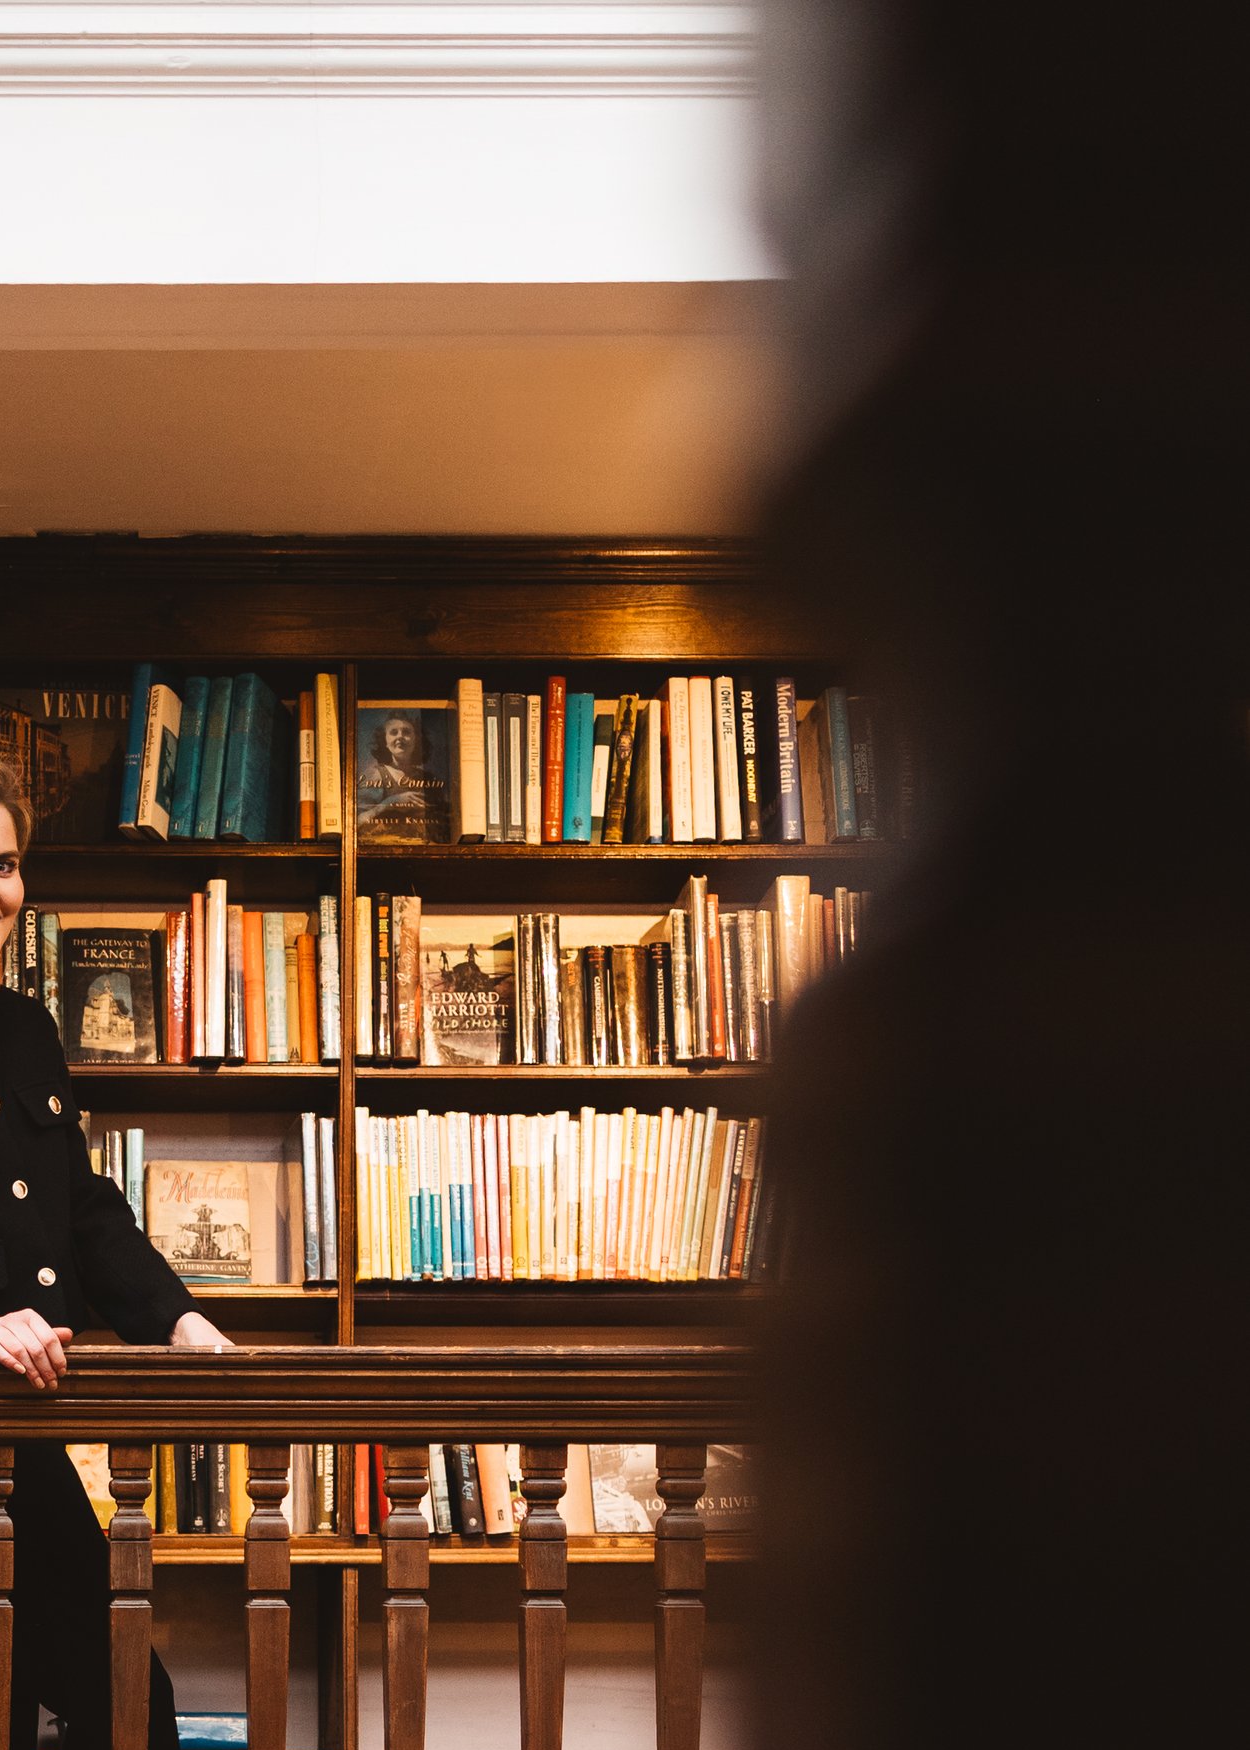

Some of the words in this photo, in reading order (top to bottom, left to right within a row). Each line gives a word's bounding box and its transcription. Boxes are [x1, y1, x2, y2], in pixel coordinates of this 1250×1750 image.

[741, 691, 753, 711] PAT
[776, 684, 794, 739] Modern
[743, 711, 756, 756] BARKER
[746, 759, 757, 804] NOONDAY
[780, 740, 796, 794] Britain
[25, 909, 37, 969] CORSICA
[73, 938, 88, 946] THE
[90, 939, 133, 947] GATEWAY
[136, 940, 148, 948] TO
[83, 948, 136, 960] FRANCE
[432, 992, 499, 1003] EDWARD
